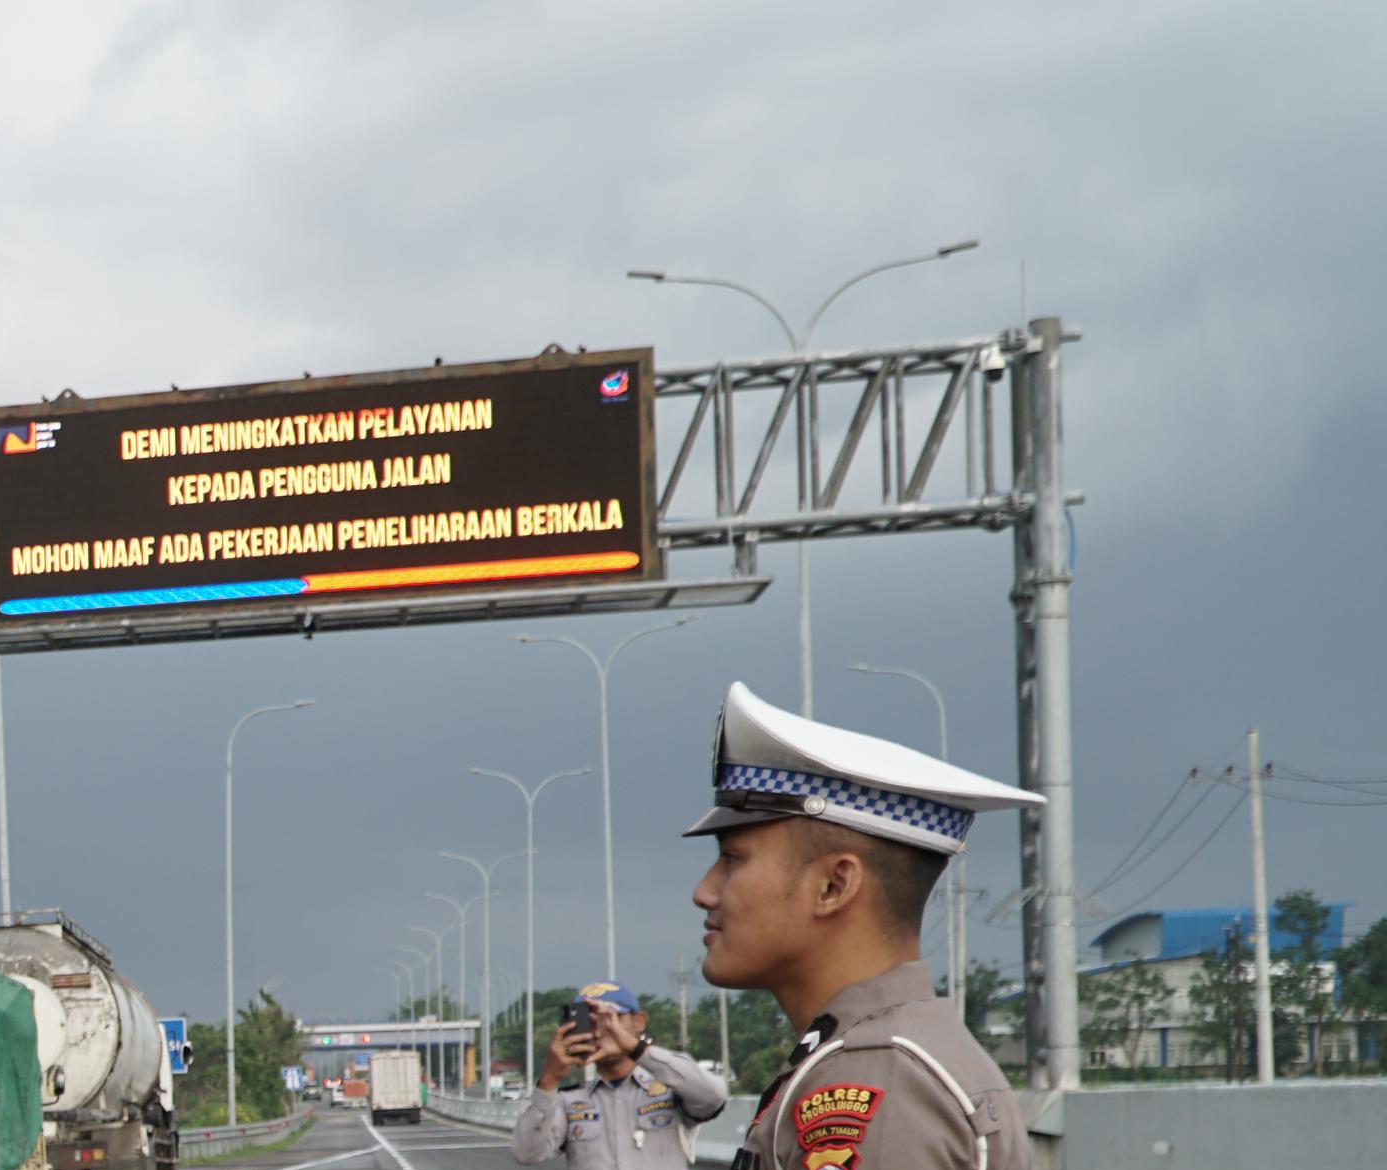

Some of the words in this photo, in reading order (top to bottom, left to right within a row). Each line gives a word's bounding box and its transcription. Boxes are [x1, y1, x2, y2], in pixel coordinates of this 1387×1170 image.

[121, 427, 176, 460] DEMI
[180, 411, 355, 456] MENINGKATKAN
[358, 398, 492, 440] PELAYANAN
[169, 470, 255, 505] KEPADA
[259, 460, 377, 498] PENGGUNA
[381, 453, 451, 488] JALAN
[12, 542, 89, 575] MOHON
[93, 536, 155, 569] MAAF
[159, 532, 204, 564] ADA
[208, 522, 334, 560] PEKERJAAN
[338, 508, 512, 550] PEMELIHARAAN
[516, 498, 624, 537] BERKALA
[801, 1100, 869, 1124] PROBOLINGGO
[802, 1088, 871, 1112] POLRES
